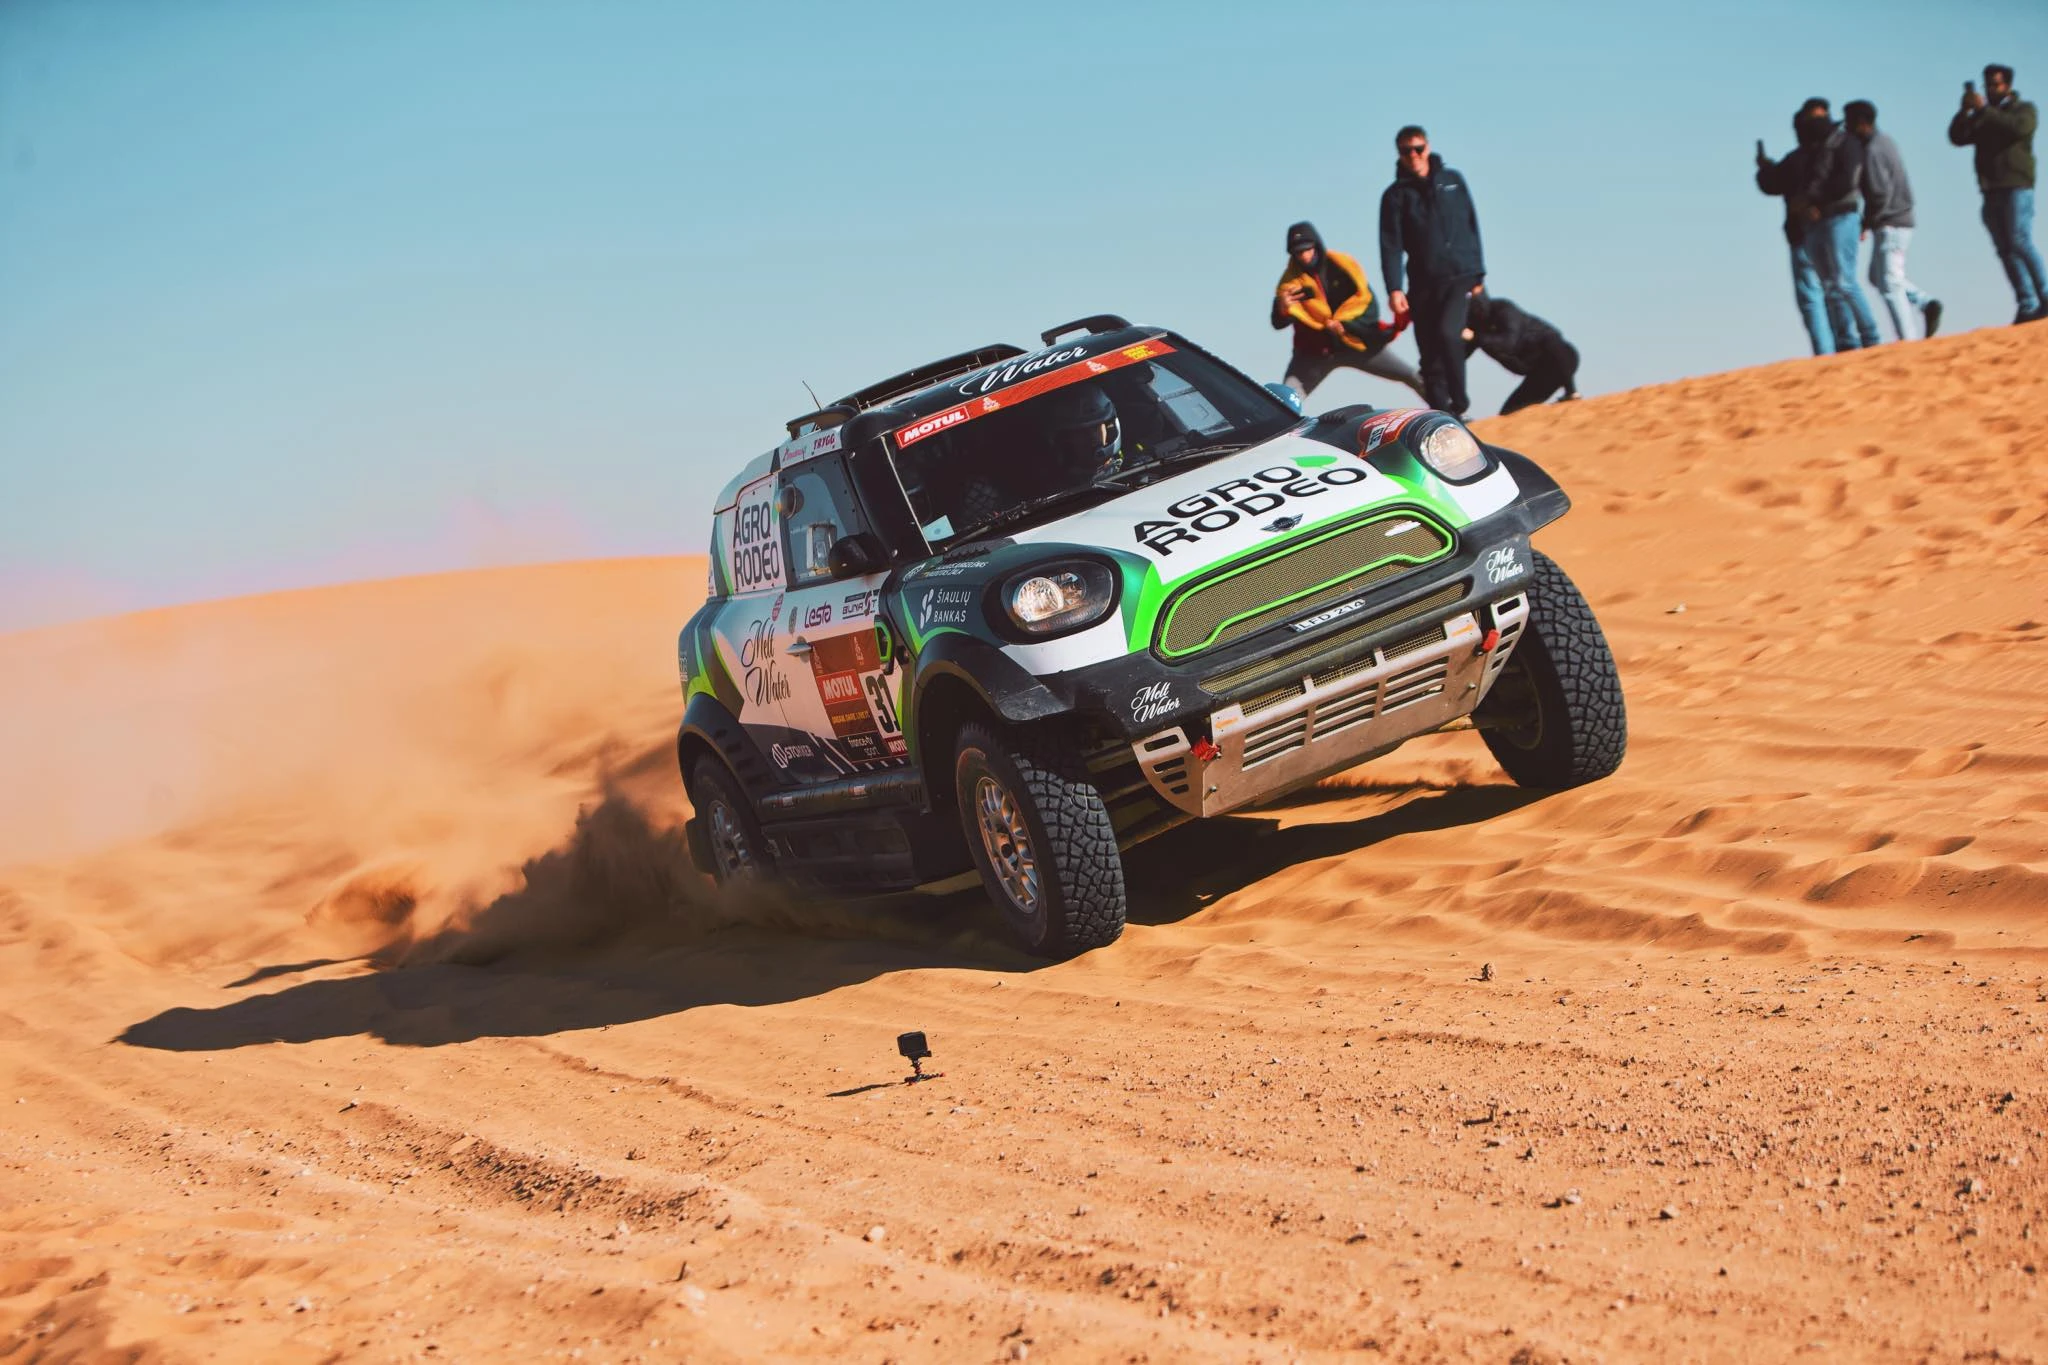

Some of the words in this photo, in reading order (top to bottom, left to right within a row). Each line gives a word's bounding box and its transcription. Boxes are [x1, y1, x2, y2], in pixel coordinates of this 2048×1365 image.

[959, 346, 1088, 395] Water
[903, 409, 964, 442] MOTUL
[1134, 465, 1303, 544] AGRO
[1143, 467, 1368, 556] RODEO
[733, 501, 771, 547] AGRO
[735, 540, 780, 590] RODEO
[1485, 544, 1516, 572] Melt
[1488, 559, 1525, 585] Water
[936, 588, 971, 606] ŠIAULIŲ
[933, 609, 967, 623] BANKAS
[1298, 613, 1332, 631] LFD
[1334, 598, 1365, 615] 214
[741, 617, 776, 668] Melt
[745, 659, 792, 707] Water
[822, 675, 858, 701] MOTUL
[1130, 680, 1171, 711] Melt
[1134, 697, 1181, 724] Water
